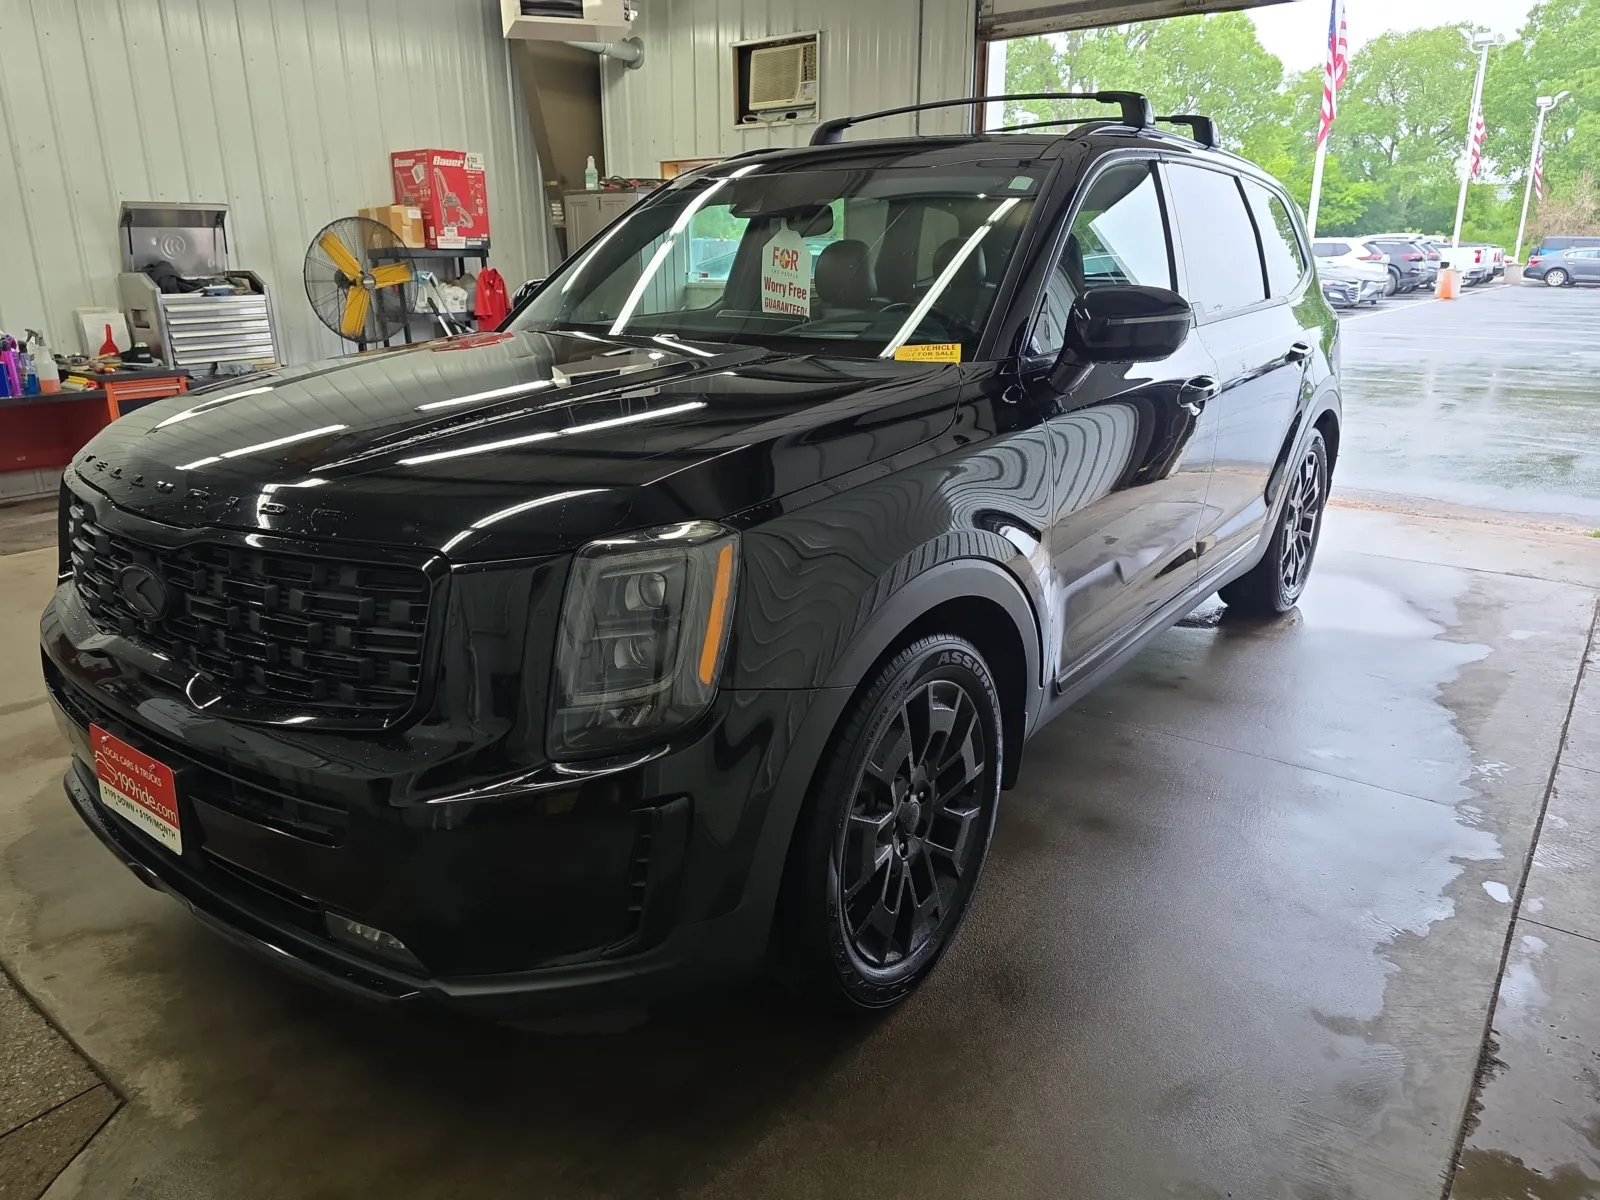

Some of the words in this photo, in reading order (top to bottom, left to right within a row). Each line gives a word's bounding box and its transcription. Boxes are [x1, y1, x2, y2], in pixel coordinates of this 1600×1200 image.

[433, 155, 464, 167] Bauer
[772, 246, 799, 271] FOR
[764, 276, 787, 298] Worry
[788, 281, 807, 300] Free
[102, 745, 120, 763] LOCAL
[119, 757, 135, 772] CARS
[139, 767, 162, 788] TRUCKS
[103, 786, 117, 800] $199
[116, 795, 135, 813] DOWN
